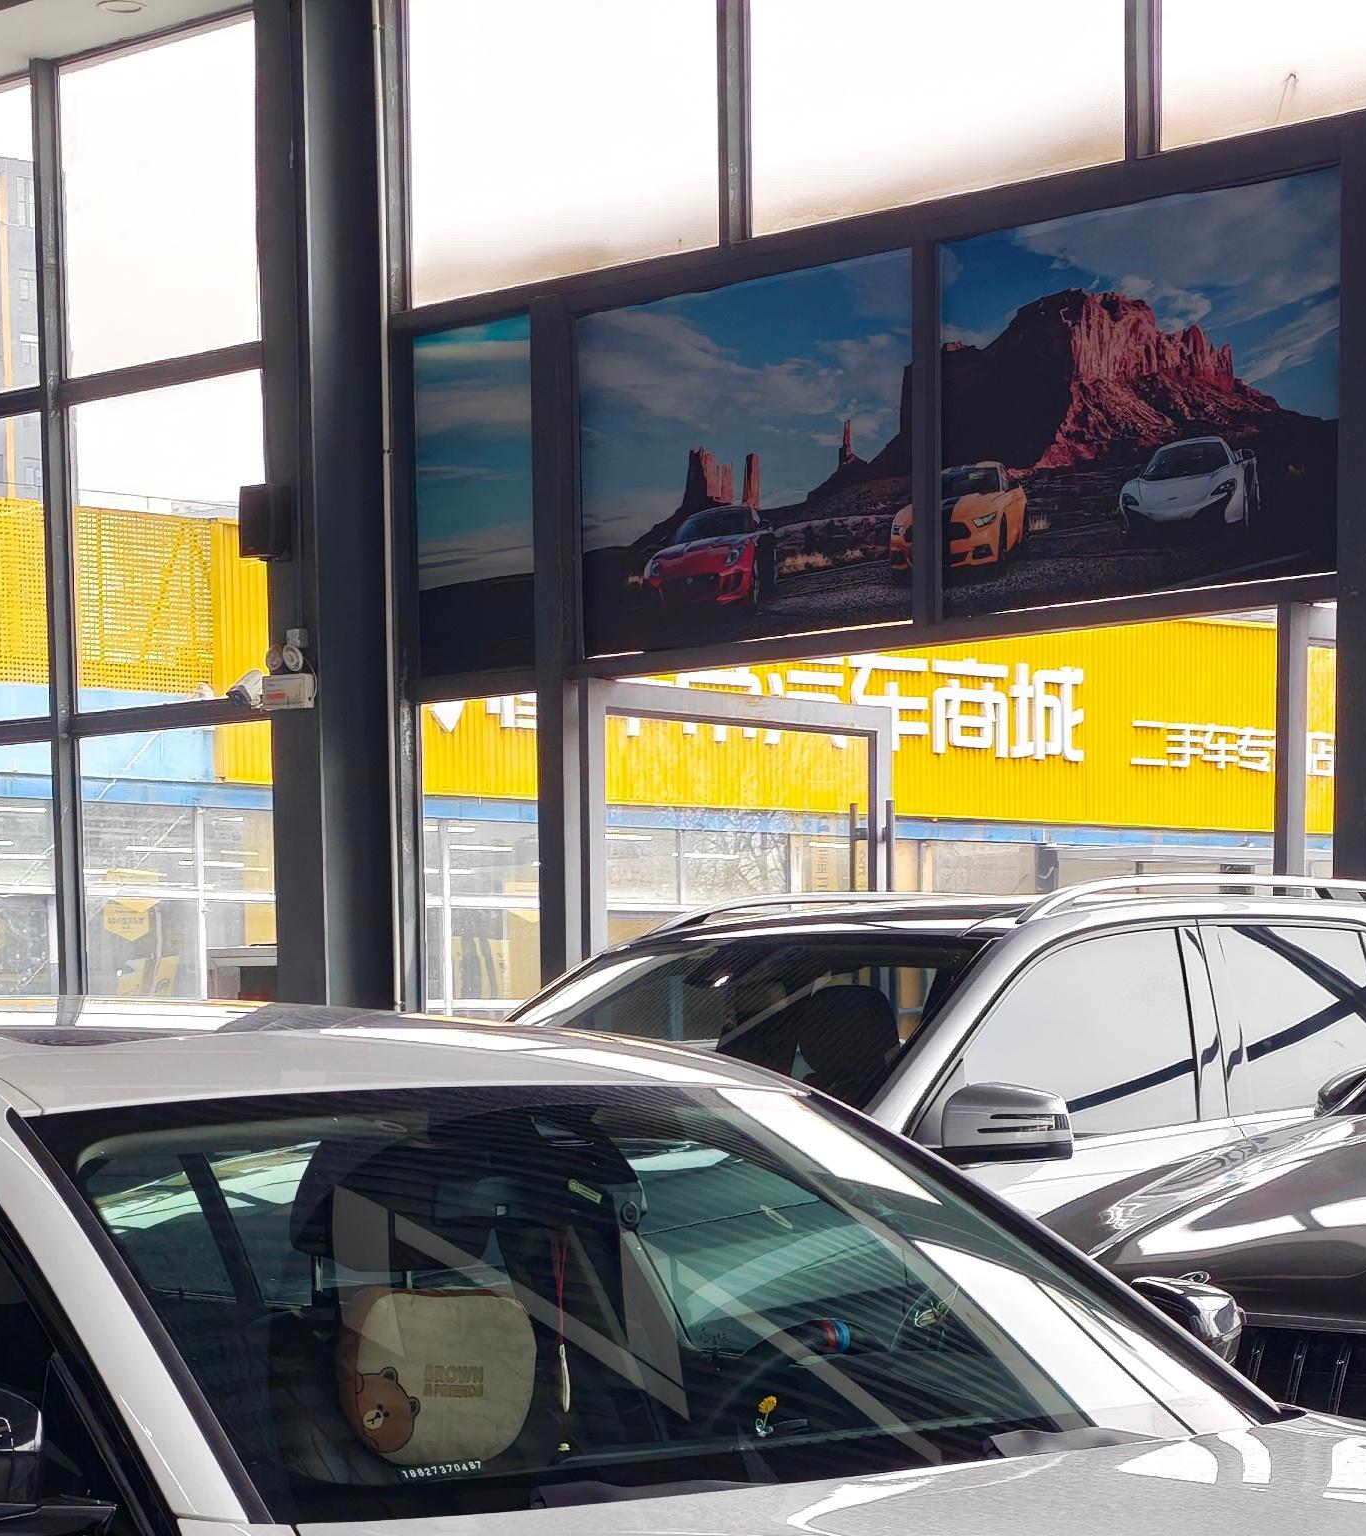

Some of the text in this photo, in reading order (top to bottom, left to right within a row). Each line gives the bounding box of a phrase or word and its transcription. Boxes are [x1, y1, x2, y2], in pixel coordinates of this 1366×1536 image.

[1130, 717, 1335, 777] 二手车专店
[401, 1460, 481, 1479] 18827370487
